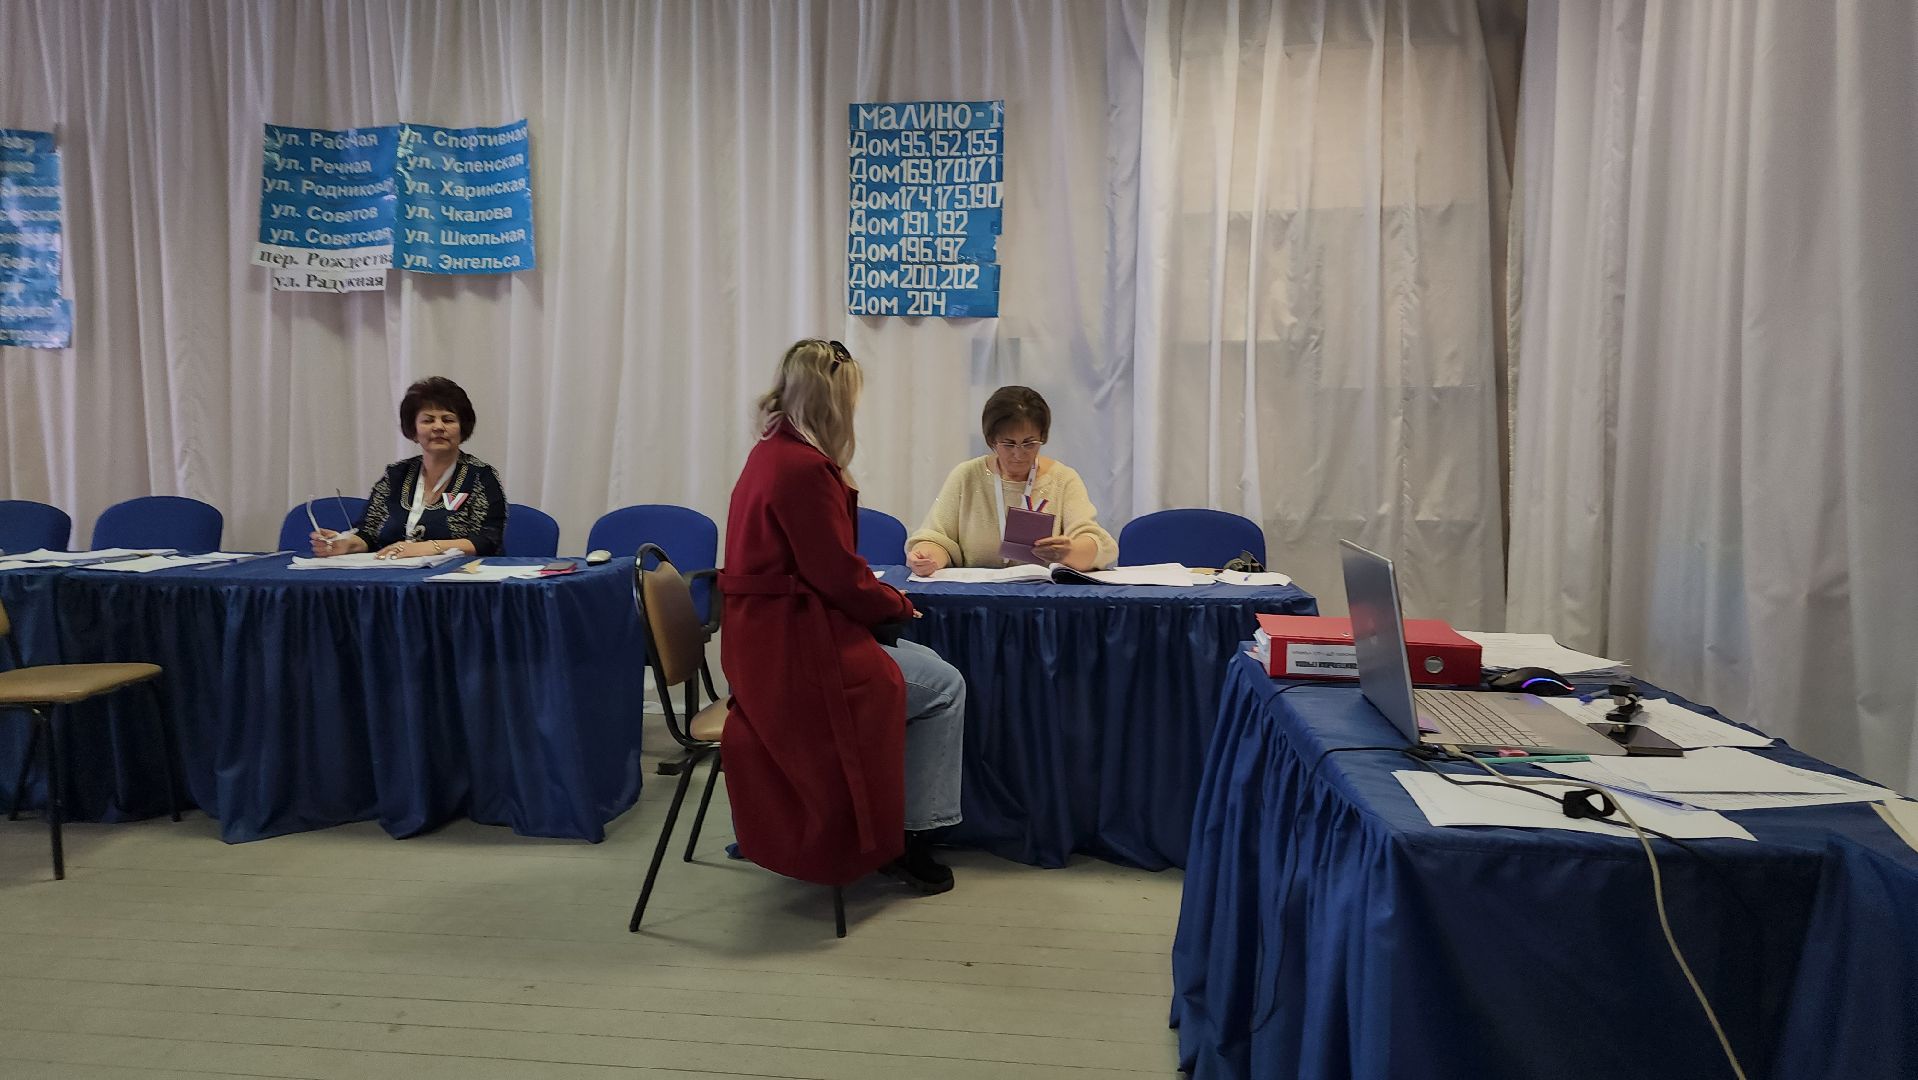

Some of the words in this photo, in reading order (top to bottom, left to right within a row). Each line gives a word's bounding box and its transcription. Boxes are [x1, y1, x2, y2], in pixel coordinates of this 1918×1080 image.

[433, 126, 528, 151] Спортивная
[850, 131, 899, 157] Дом
[311, 157, 373, 174] Речная
[405, 155, 436, 170] ул.
[442, 153, 524, 173] Успенская
[849, 158, 899, 183] Дом
[264, 177, 295, 193] ул.
[405, 180, 435, 195] ул.
[440, 178, 526, 200] Харинская
[849, 184, 899, 210] Дом
[270, 203, 301, 219] ул.
[306, 206, 378, 223] Советов
[404, 203, 435, 220] ул.
[440, 205, 513, 222] Чкалова
[850, 210, 898, 235] Дом
[269, 227, 299, 243] ул.
[404, 228, 434, 244] ул.
[440, 228, 526, 246] Школьная
[259, 250, 299, 268] пер.
[849, 237, 898, 262] Дом
[402, 252, 433, 269] ул.
[438, 254, 521, 270] Энгельса
[849, 264, 898, 288] Дом
[849, 290, 898, 315] Дом
[907, 291, 946, 315] 204
